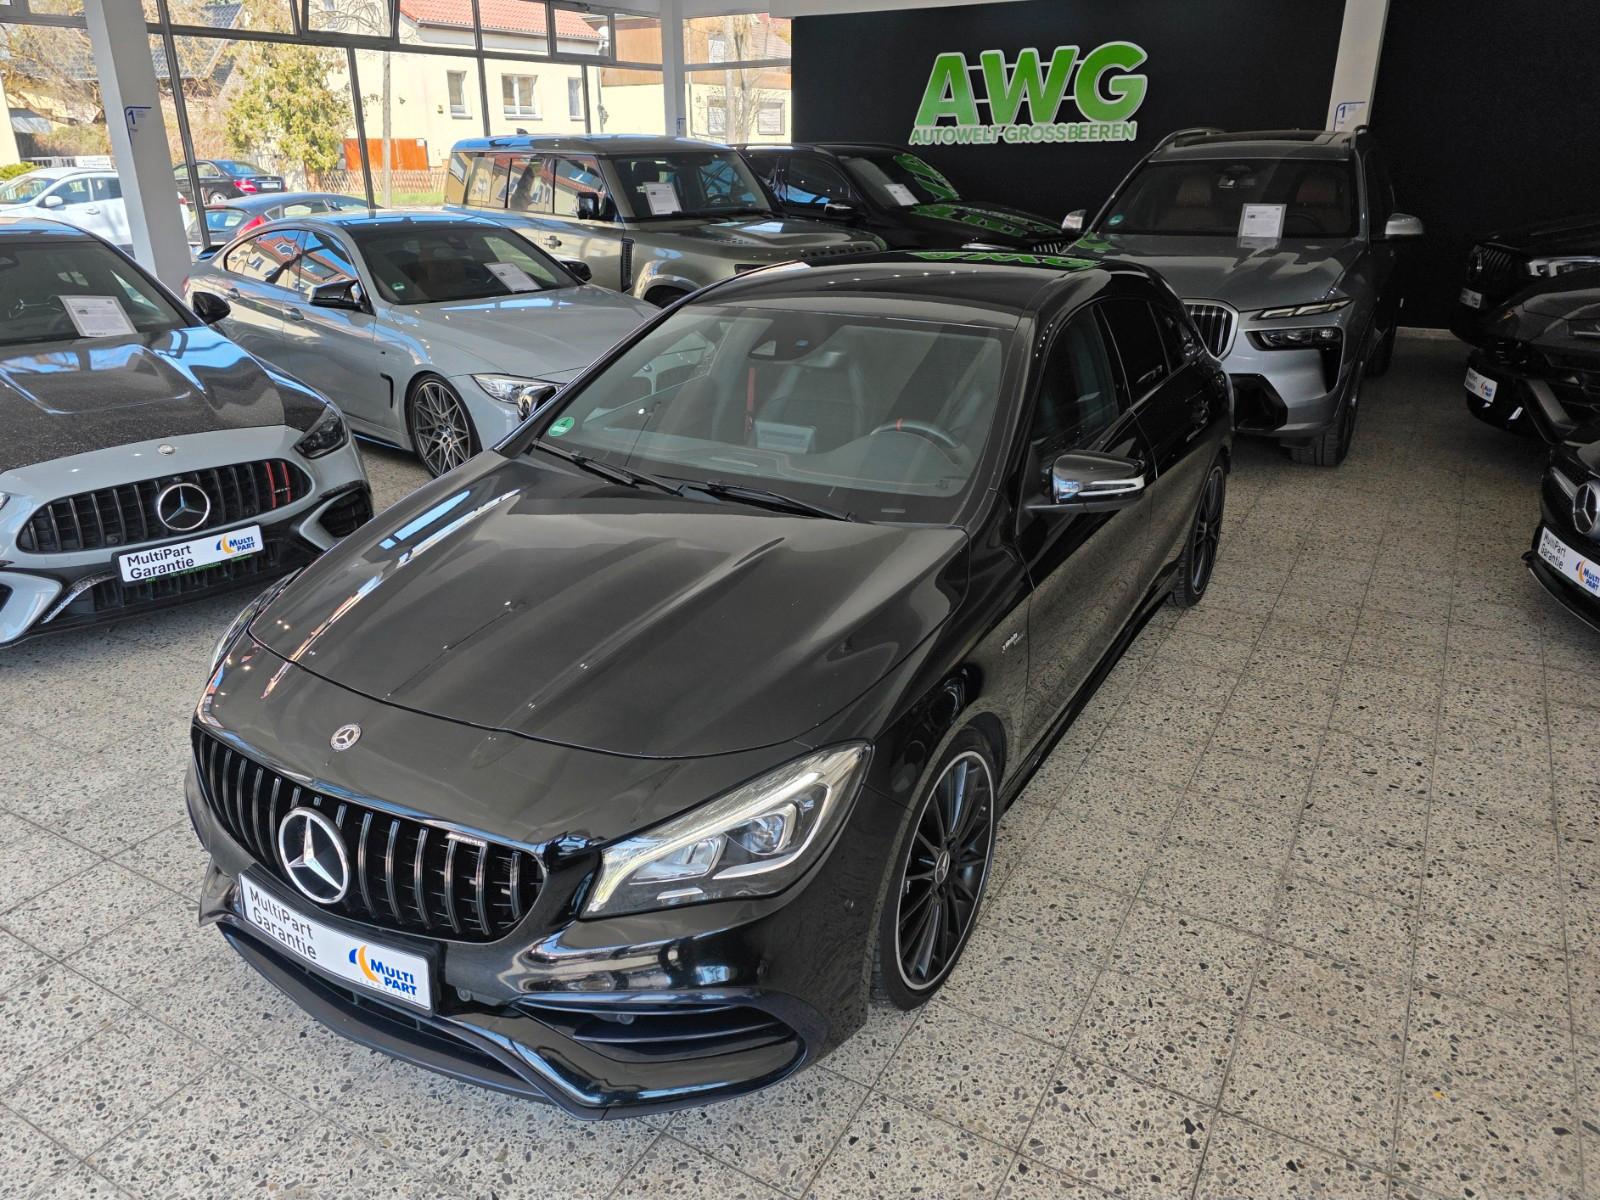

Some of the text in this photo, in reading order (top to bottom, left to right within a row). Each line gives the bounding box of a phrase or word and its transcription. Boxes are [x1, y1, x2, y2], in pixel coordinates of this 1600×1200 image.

[914, 41, 1148, 126] AWG
[128, 110, 136, 125] 1
[909, 121, 1138, 145] AUTOWELT GROSSBEEREN
[127, 545, 192, 567] MultiPart
[237, 542, 256, 552] PART
[1541, 543, 1564, 569] Garantie
[130, 558, 194, 579] Garantie
[250, 886, 314, 940] MultiPart
[253, 907, 317, 960] Garantie
[370, 959, 415, 985] MULTI
[384, 977, 417, 996] PART
